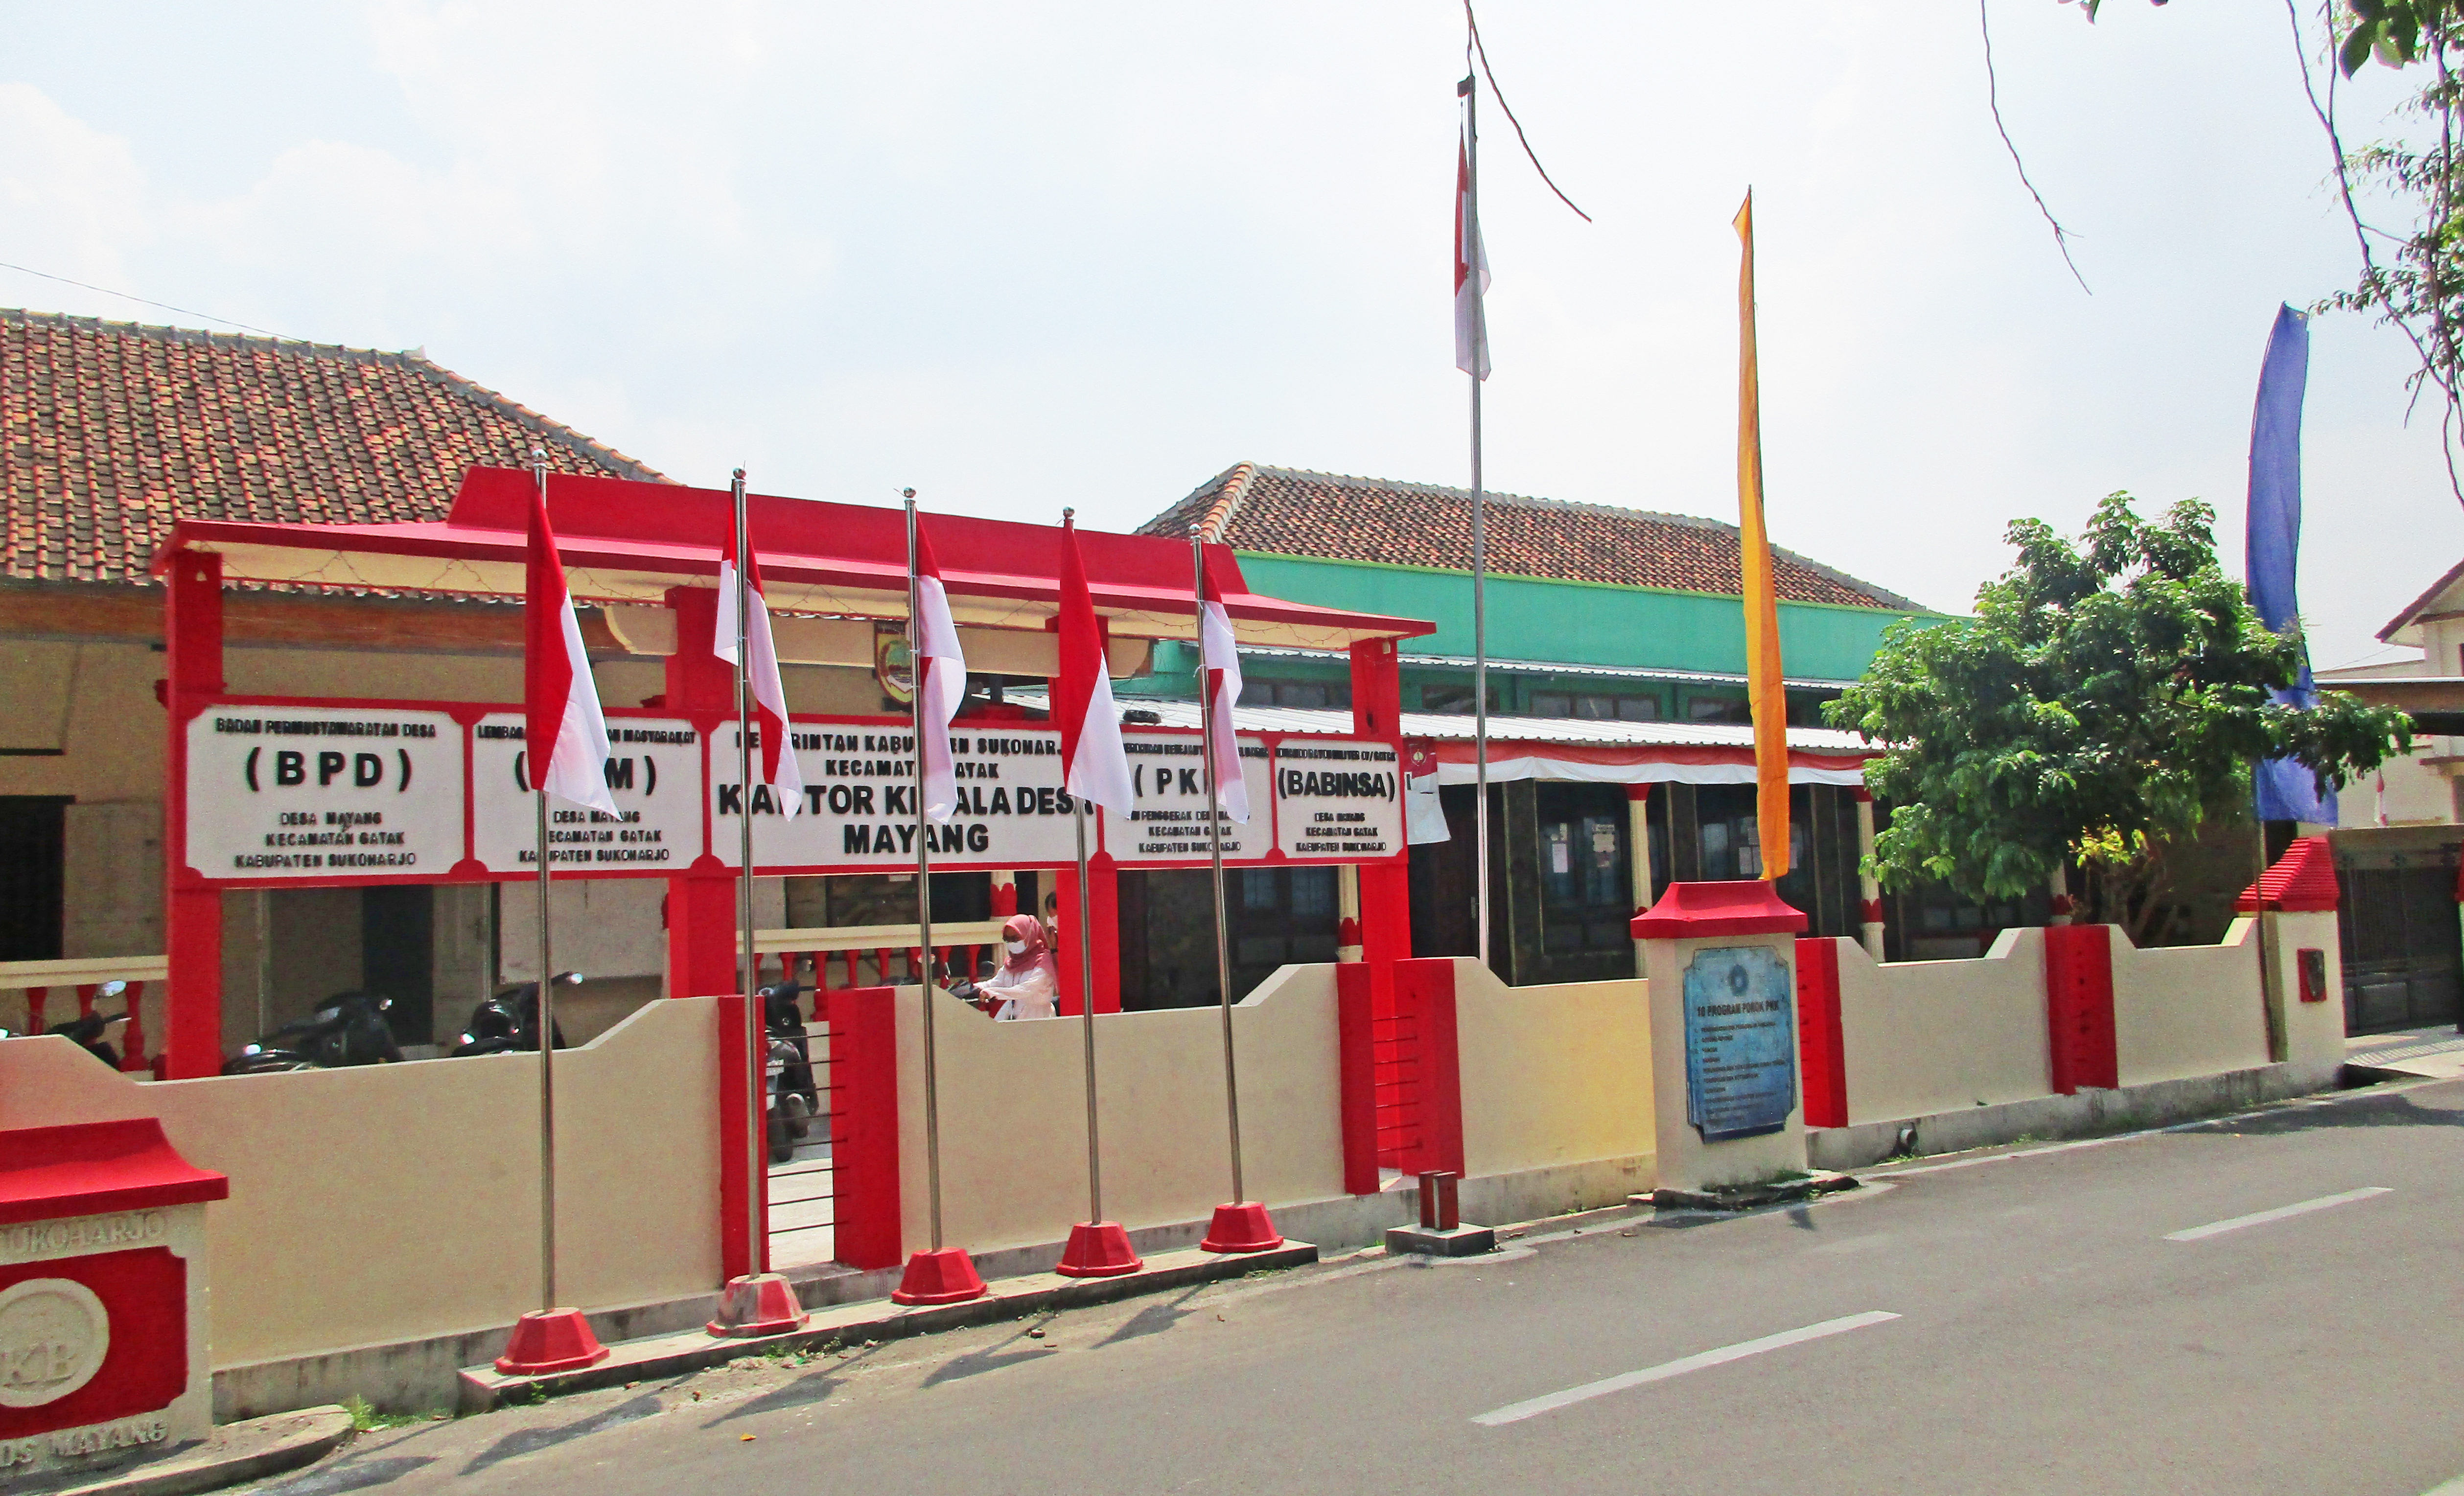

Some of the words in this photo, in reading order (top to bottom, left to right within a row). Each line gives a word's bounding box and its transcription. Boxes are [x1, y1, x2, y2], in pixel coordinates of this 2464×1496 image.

[402, 724, 435, 738] DESA
[478, 725, 525, 740] LEMBAG
[826, 760, 914, 777] KECAMAT
[954, 762, 999, 780] ATAK
[1278, 767, 1395, 803] (BABINSA)
[885, 785, 1012, 815] KALA
[1017, 786, 1094, 817] DES
[279, 812, 316, 826] DESA
[326, 812, 381, 827] MAYANG
[553, 810, 585, 824] DESA
[1314, 812, 1334, 822] DESA
[549, 830, 613, 843] ECAMATAN
[620, 830, 661, 843] GATAK
[844, 823, 989, 854] MAYANG
[1148, 826, 1201, 837] KECAMATAN
[1305, 827, 1352, 837] KECAMATAN
[1353, 827, 1378, 837] GATAK
[265, 832, 353, 847] KECAMATAN
[359, 831, 404, 845] GATAK
[1139, 842, 1189, 853] KABUPATEN
[1191, 841, 1241, 852] SUKOARJO
[1296, 842, 1340, 852] KABUPATEN
[234, 854, 322, 868] KABUPATEN
[328, 852, 416, 867] SUKOHARJO
[596, 849, 669, 862] SUKOHARJO
[0, 1214, 164, 1254] UKOHARJO
